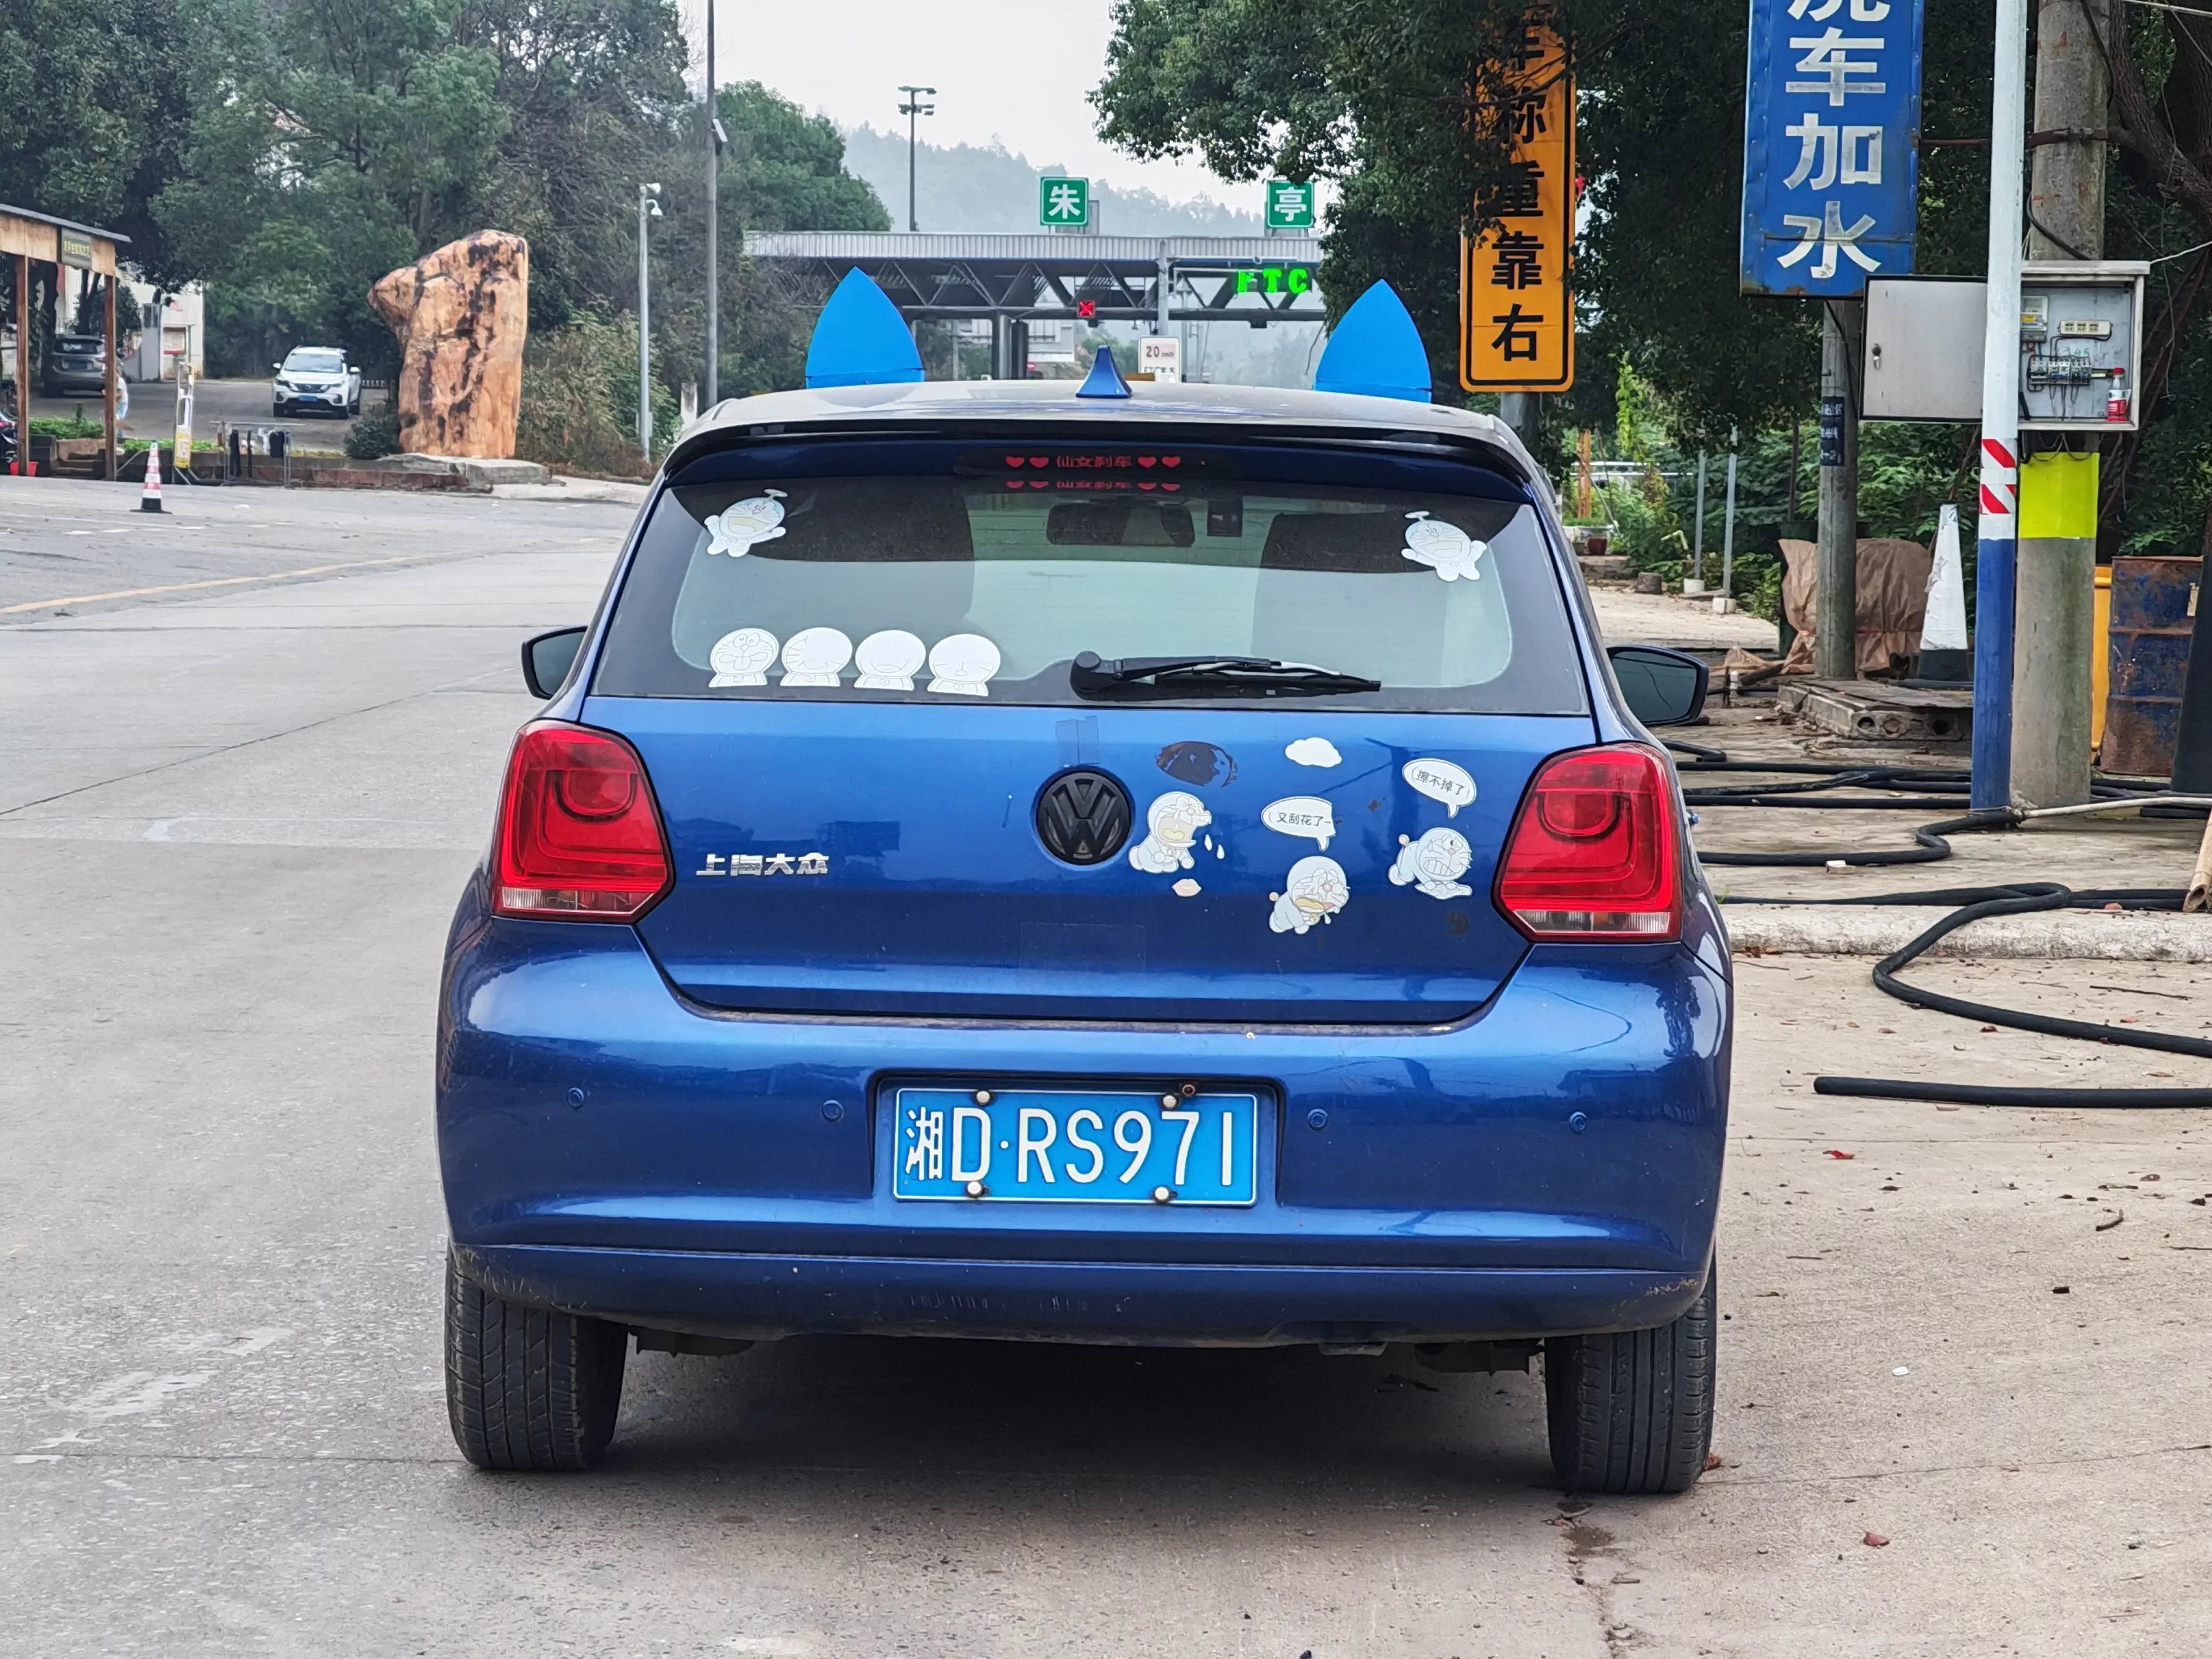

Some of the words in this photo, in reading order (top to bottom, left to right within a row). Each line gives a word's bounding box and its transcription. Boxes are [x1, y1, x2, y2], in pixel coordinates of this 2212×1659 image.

[1777, 0, 1891, 278] 车加水
[1048, 185, 1081, 219] 朱
[1274, 187, 1307, 221] 亭
[1146, 346, 1159, 358] 20
[1416, 768, 1465, 795] 擦不掉了
[696, 852, 830, 876] 上海大众
